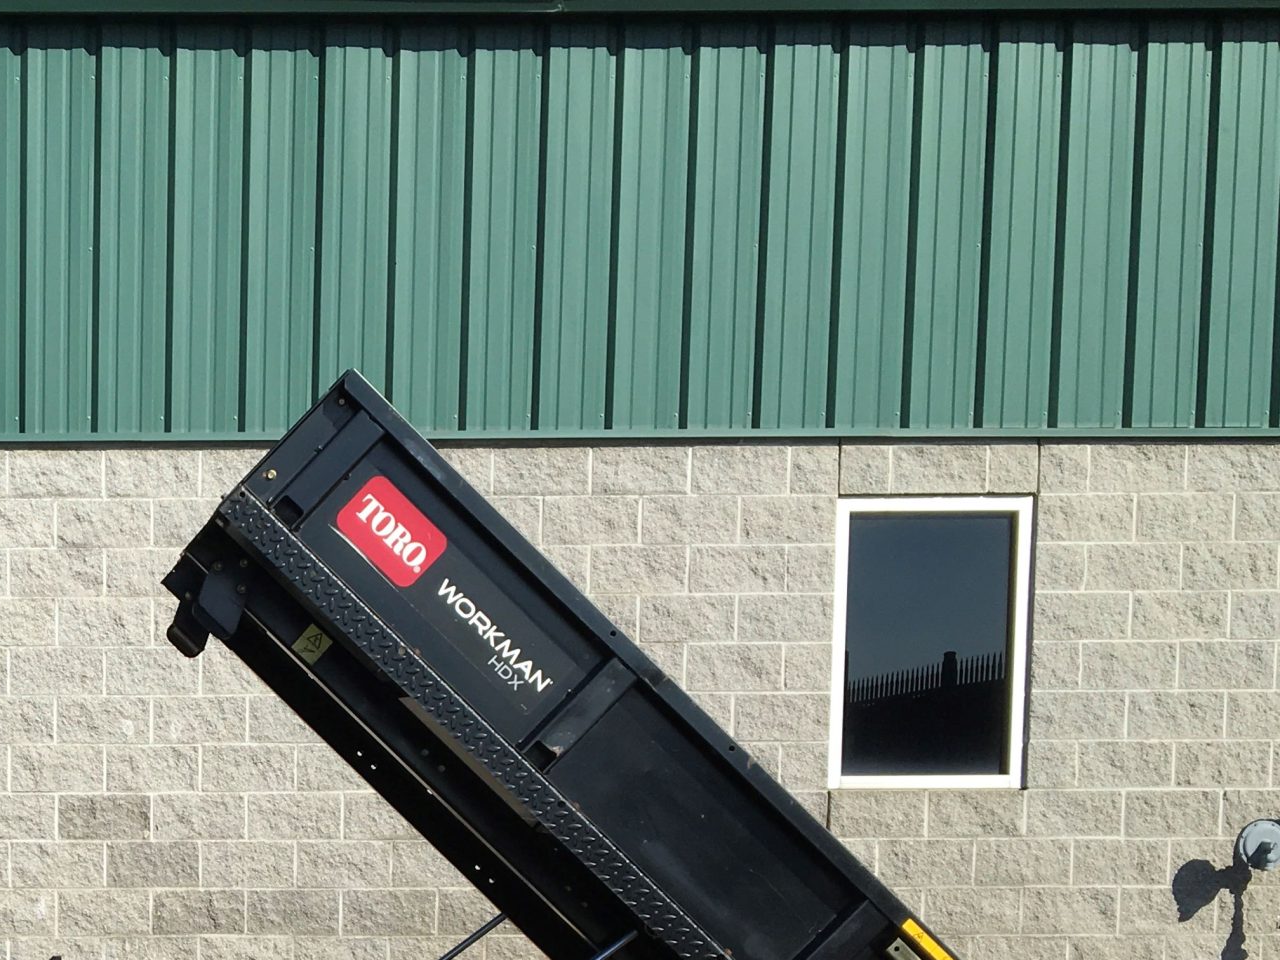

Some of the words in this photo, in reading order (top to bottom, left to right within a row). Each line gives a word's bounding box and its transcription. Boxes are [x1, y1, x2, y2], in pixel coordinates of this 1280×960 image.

[355, 493, 427, 572] TORO
[437, 577, 552, 692] WORKMAN
[487, 654, 525, 691] HDX
